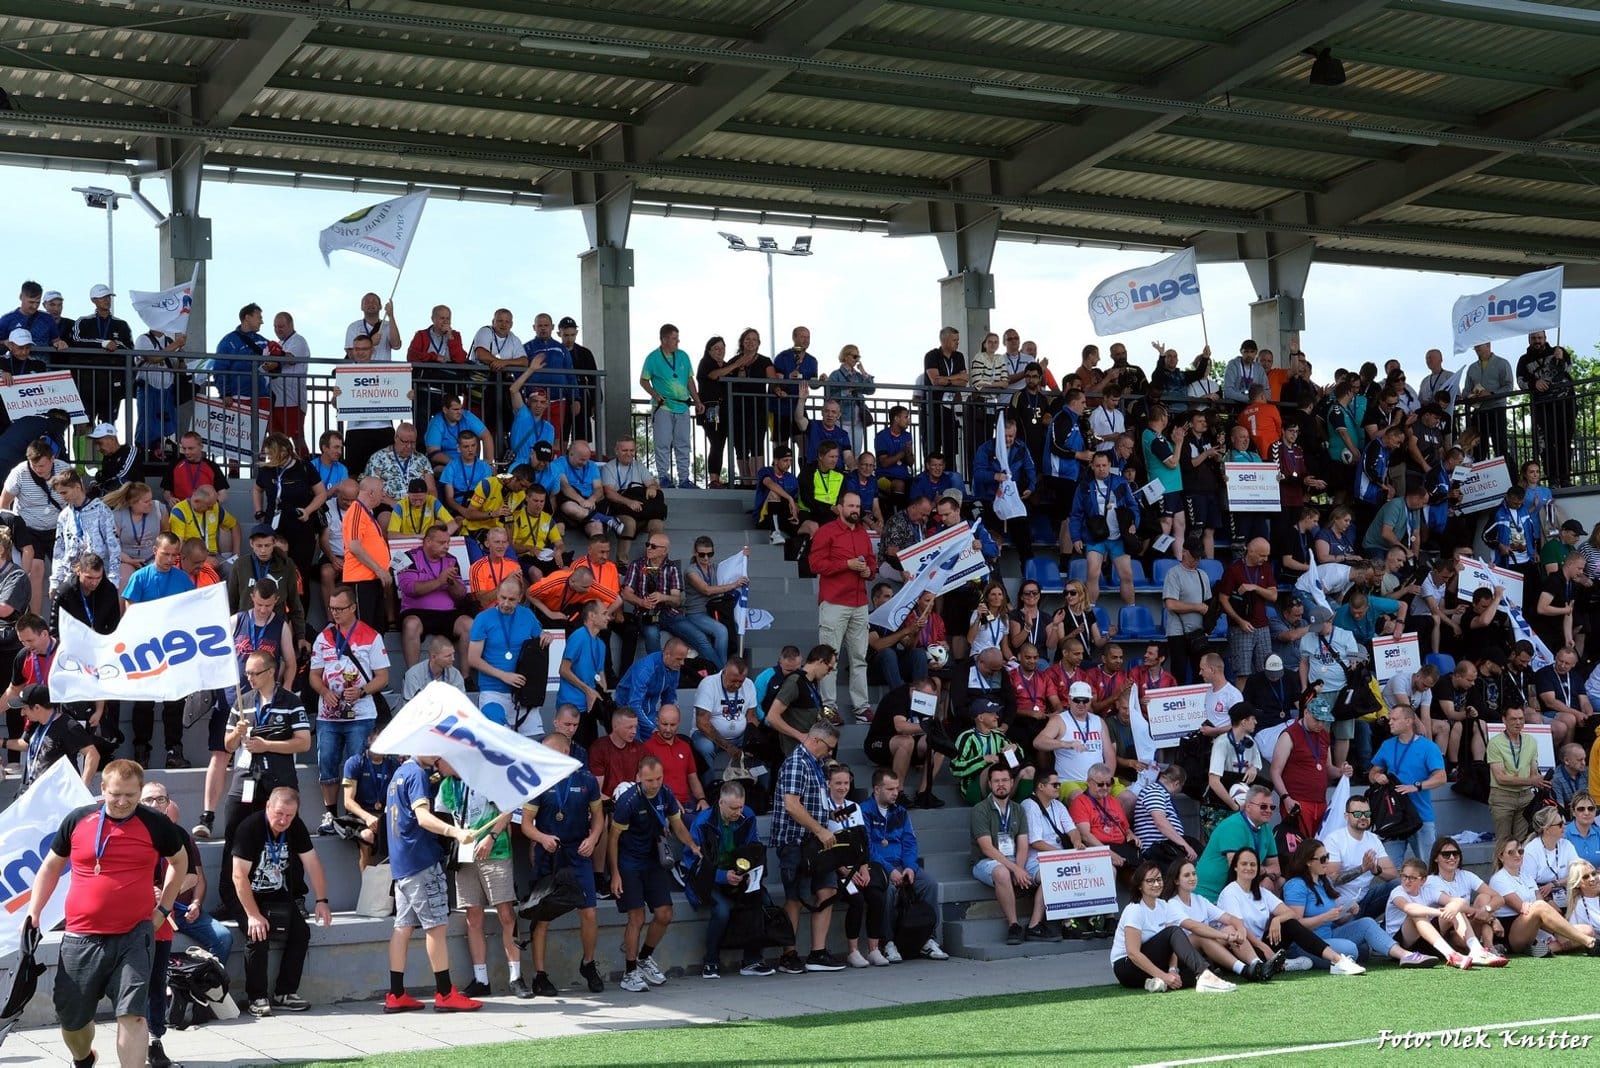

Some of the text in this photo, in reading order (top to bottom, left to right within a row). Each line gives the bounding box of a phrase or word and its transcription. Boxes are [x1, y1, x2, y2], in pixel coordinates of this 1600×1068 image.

[353, 375, 380, 387] seni
[18, 384, 44, 397] seni
[351, 386, 399, 398] TARNÓWKO
[6, 399, 34, 411] ARLAN
[210, 410, 235, 423] seni
[1238, 472, 1257, 482] seni
[1463, 479, 1498, 494] UBLINIEC
[1384, 645, 1400, 658] seni
[1162, 698, 1186, 711] seni
[1056, 862, 1081, 877] seni
[1051, 877, 1106, 892] SKWIERZYNA
